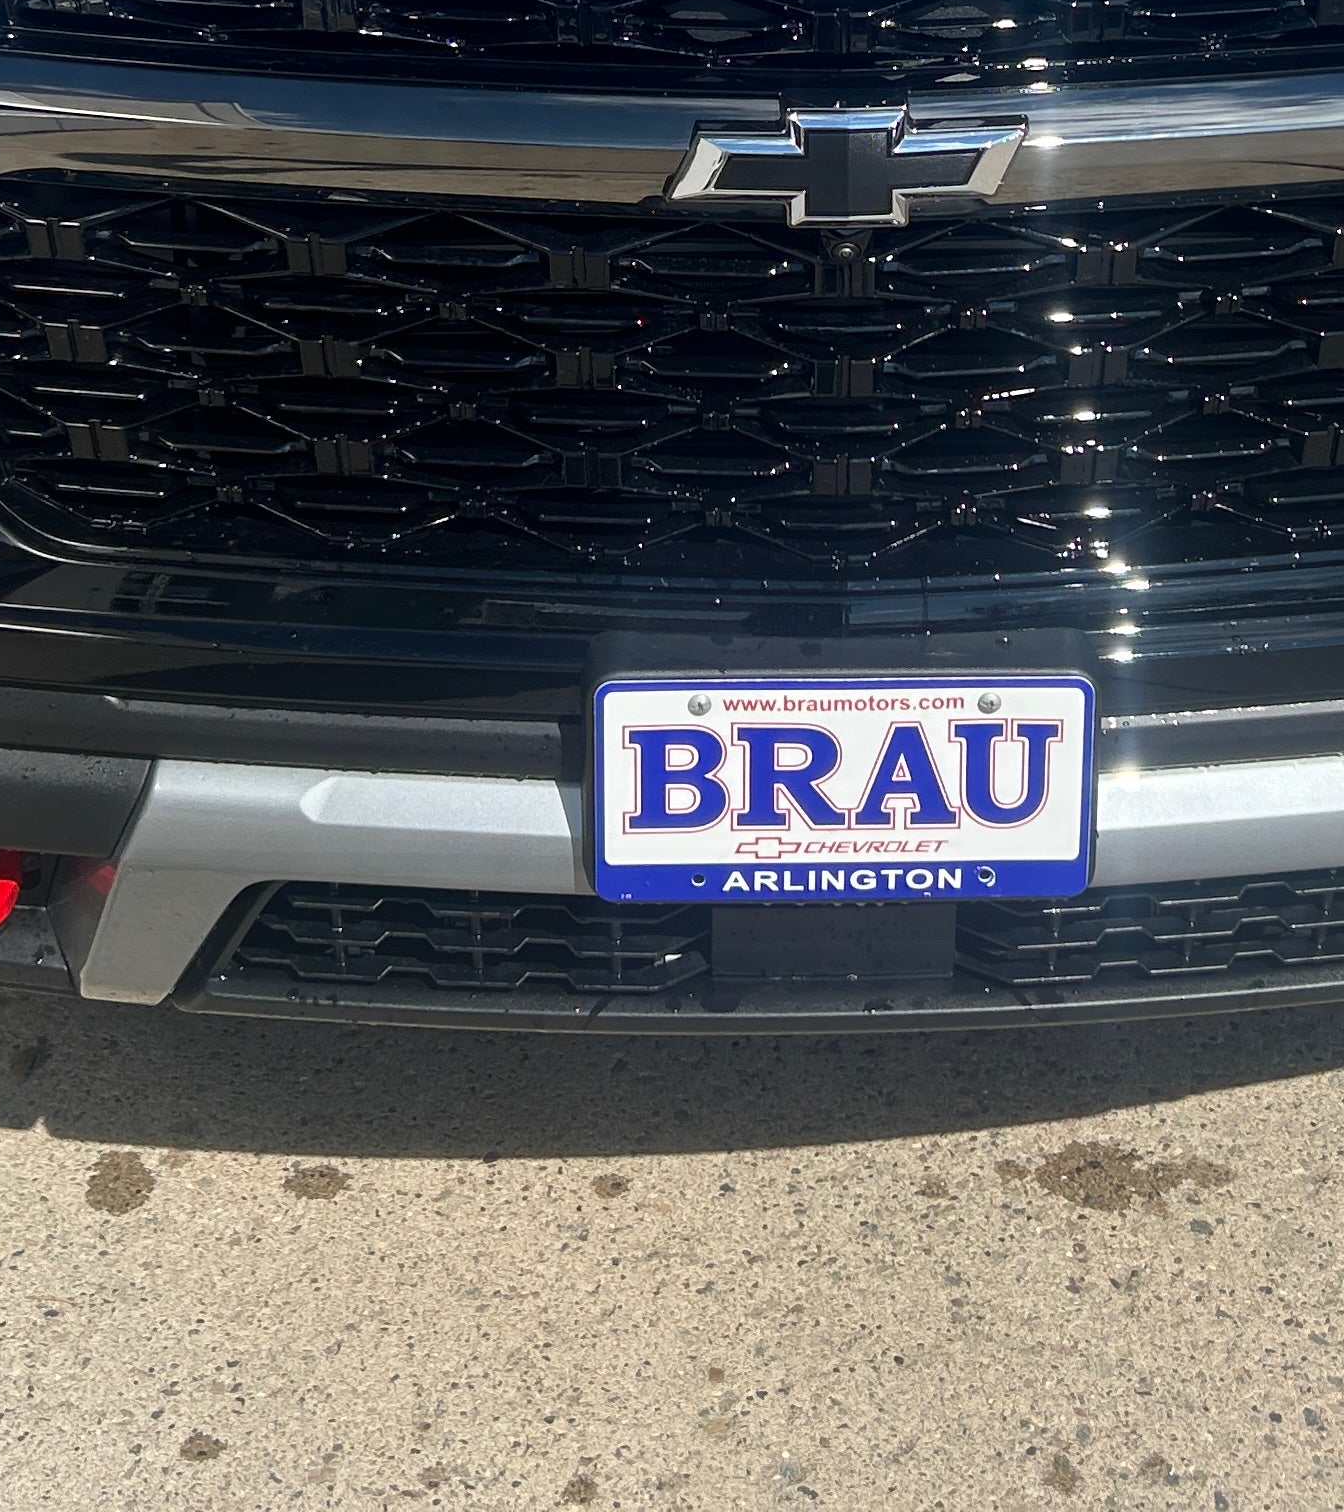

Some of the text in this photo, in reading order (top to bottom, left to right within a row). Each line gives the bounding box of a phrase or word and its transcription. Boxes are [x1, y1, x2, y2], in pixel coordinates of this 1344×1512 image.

[722, 692, 966, 713] www.braumotors.com
[622, 718, 1064, 835] BRAU
[804, 839, 949, 855] CHEVROLET
[722, 868, 962, 892] ARLINGTON
